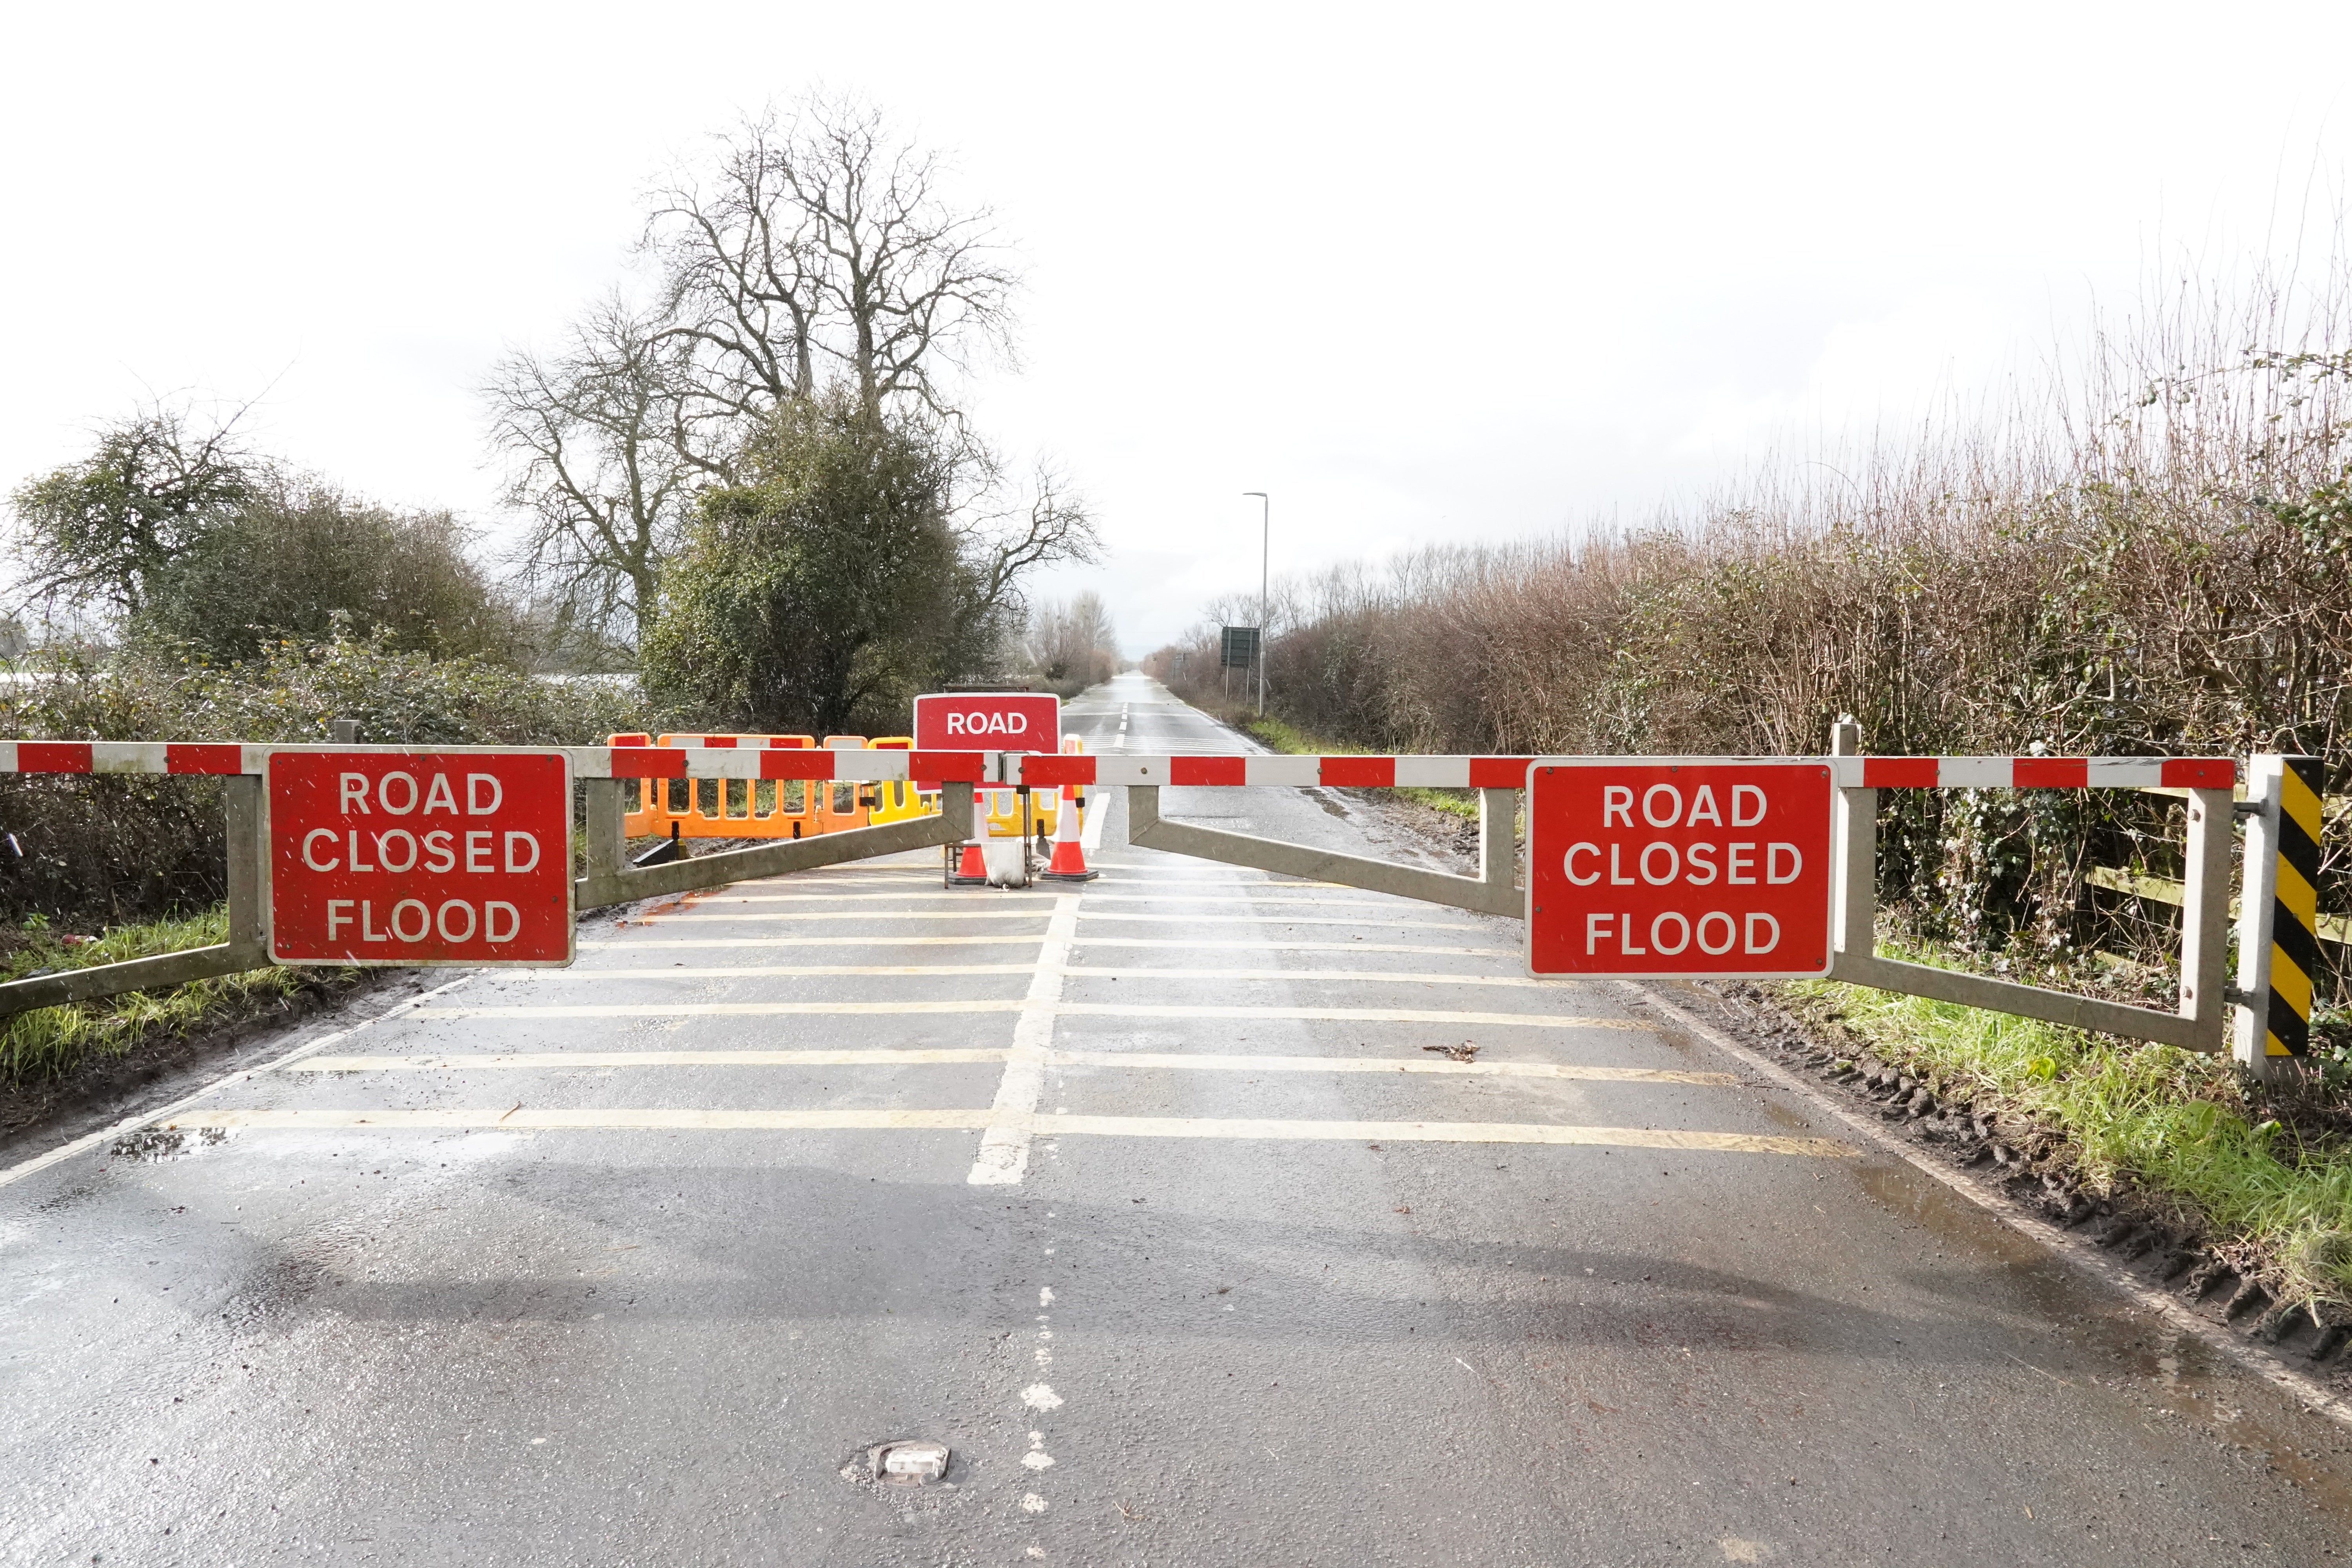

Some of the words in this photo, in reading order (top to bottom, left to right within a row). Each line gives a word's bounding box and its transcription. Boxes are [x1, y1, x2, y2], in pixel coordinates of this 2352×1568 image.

[947, 712, 1027, 734] ROAD
[340, 771, 503, 815] ROAD
[1604, 784, 1767, 828] ROAD
[303, 828, 540, 873] CLOSED
[1564, 842, 1802, 886] CLOSED
[328, 899, 520, 943] FLOOD
[1586, 911, 1780, 955] FLOOD
